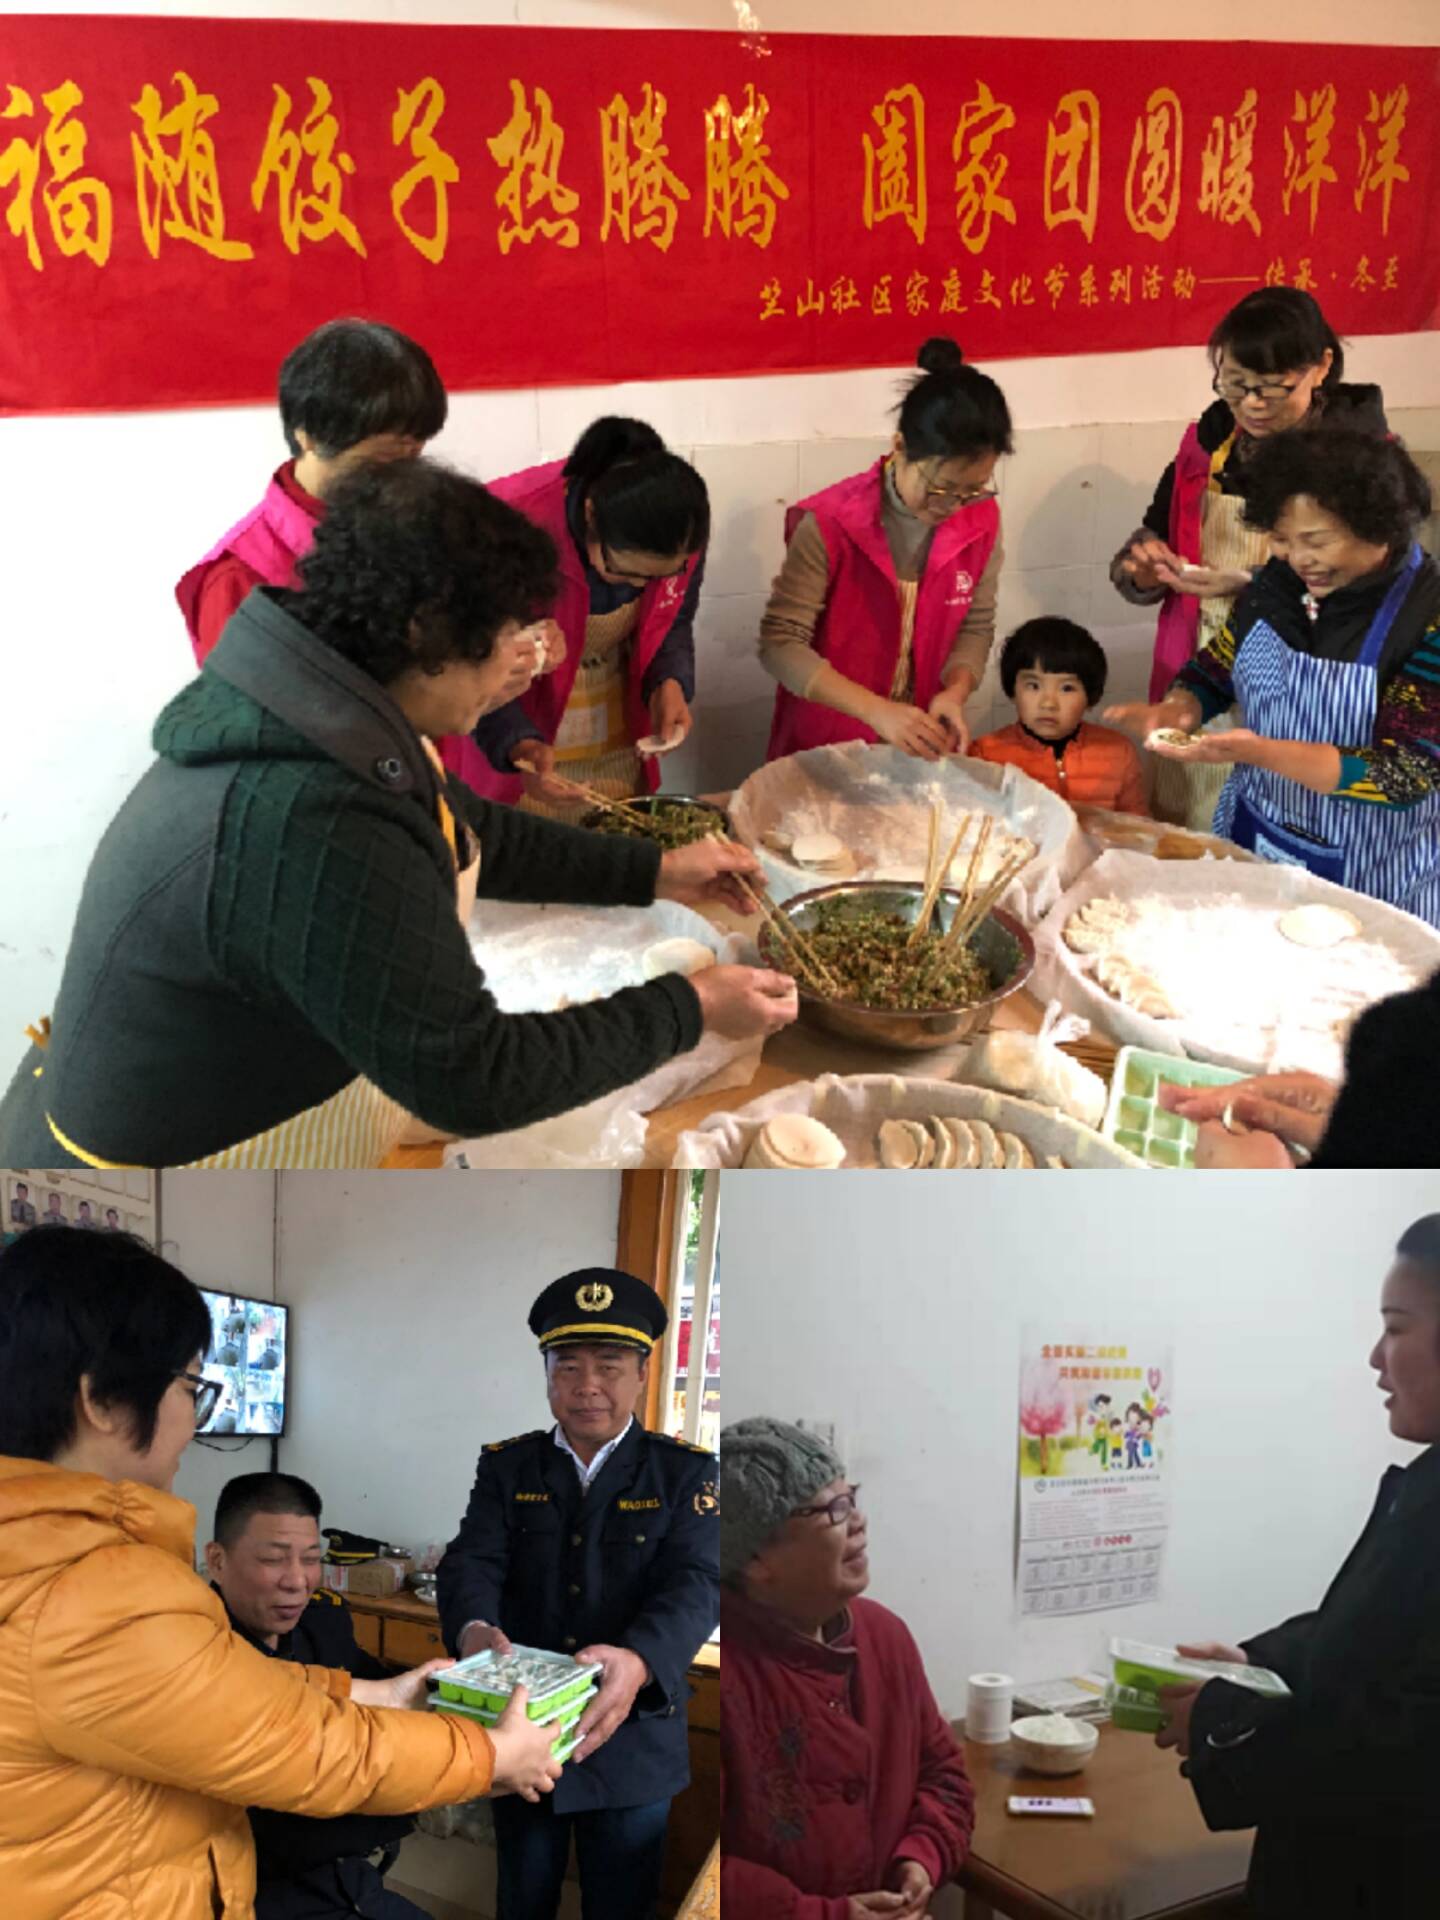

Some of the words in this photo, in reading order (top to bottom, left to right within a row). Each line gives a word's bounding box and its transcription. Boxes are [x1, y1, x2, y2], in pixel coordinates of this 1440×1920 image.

[0, 71, 790, 272] 福随饺子热腾腾
[862, 80, 1411, 254] 阖家团圆暖洋洋
